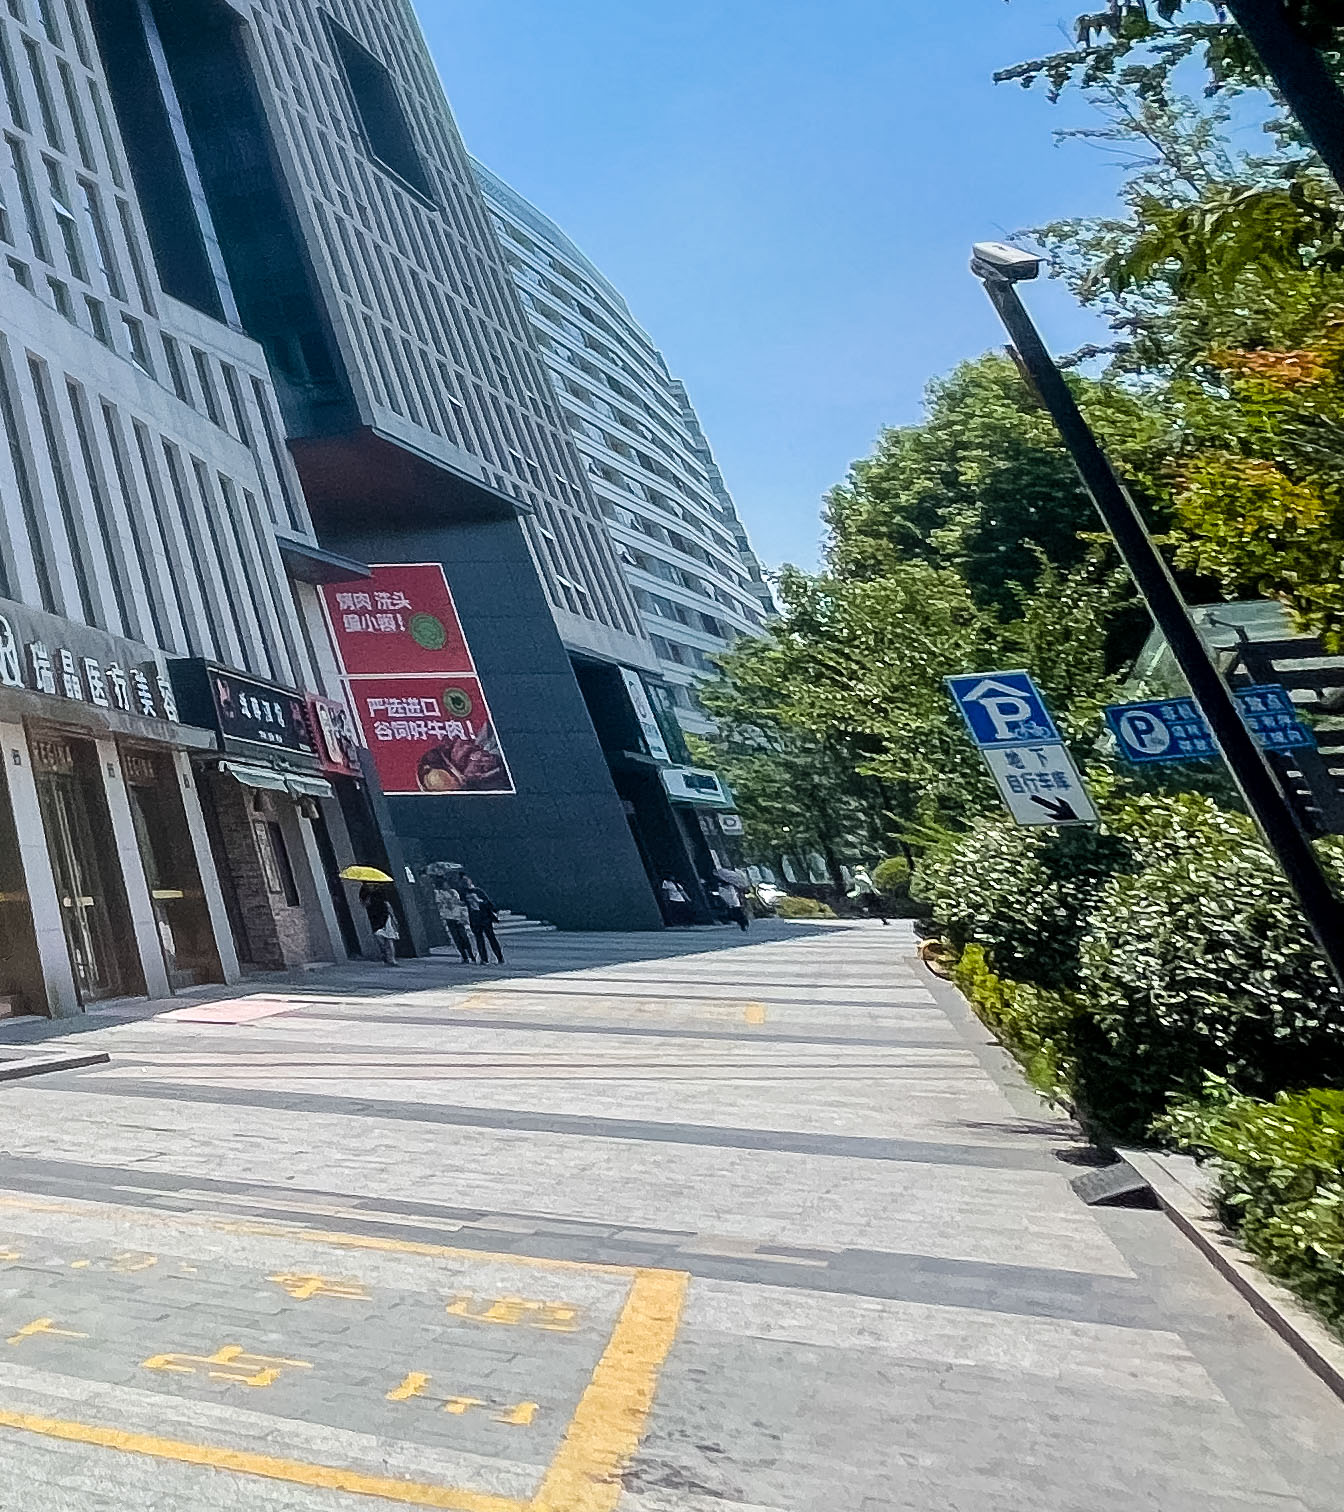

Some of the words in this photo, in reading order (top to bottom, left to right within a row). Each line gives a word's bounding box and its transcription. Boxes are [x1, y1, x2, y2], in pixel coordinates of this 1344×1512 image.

[366, 697, 441, 717] 严选进口
[978, 696, 1031, 739] P
[1127, 716, 1155, 748] P
[1005, 770, 1072, 794] 自行车库
